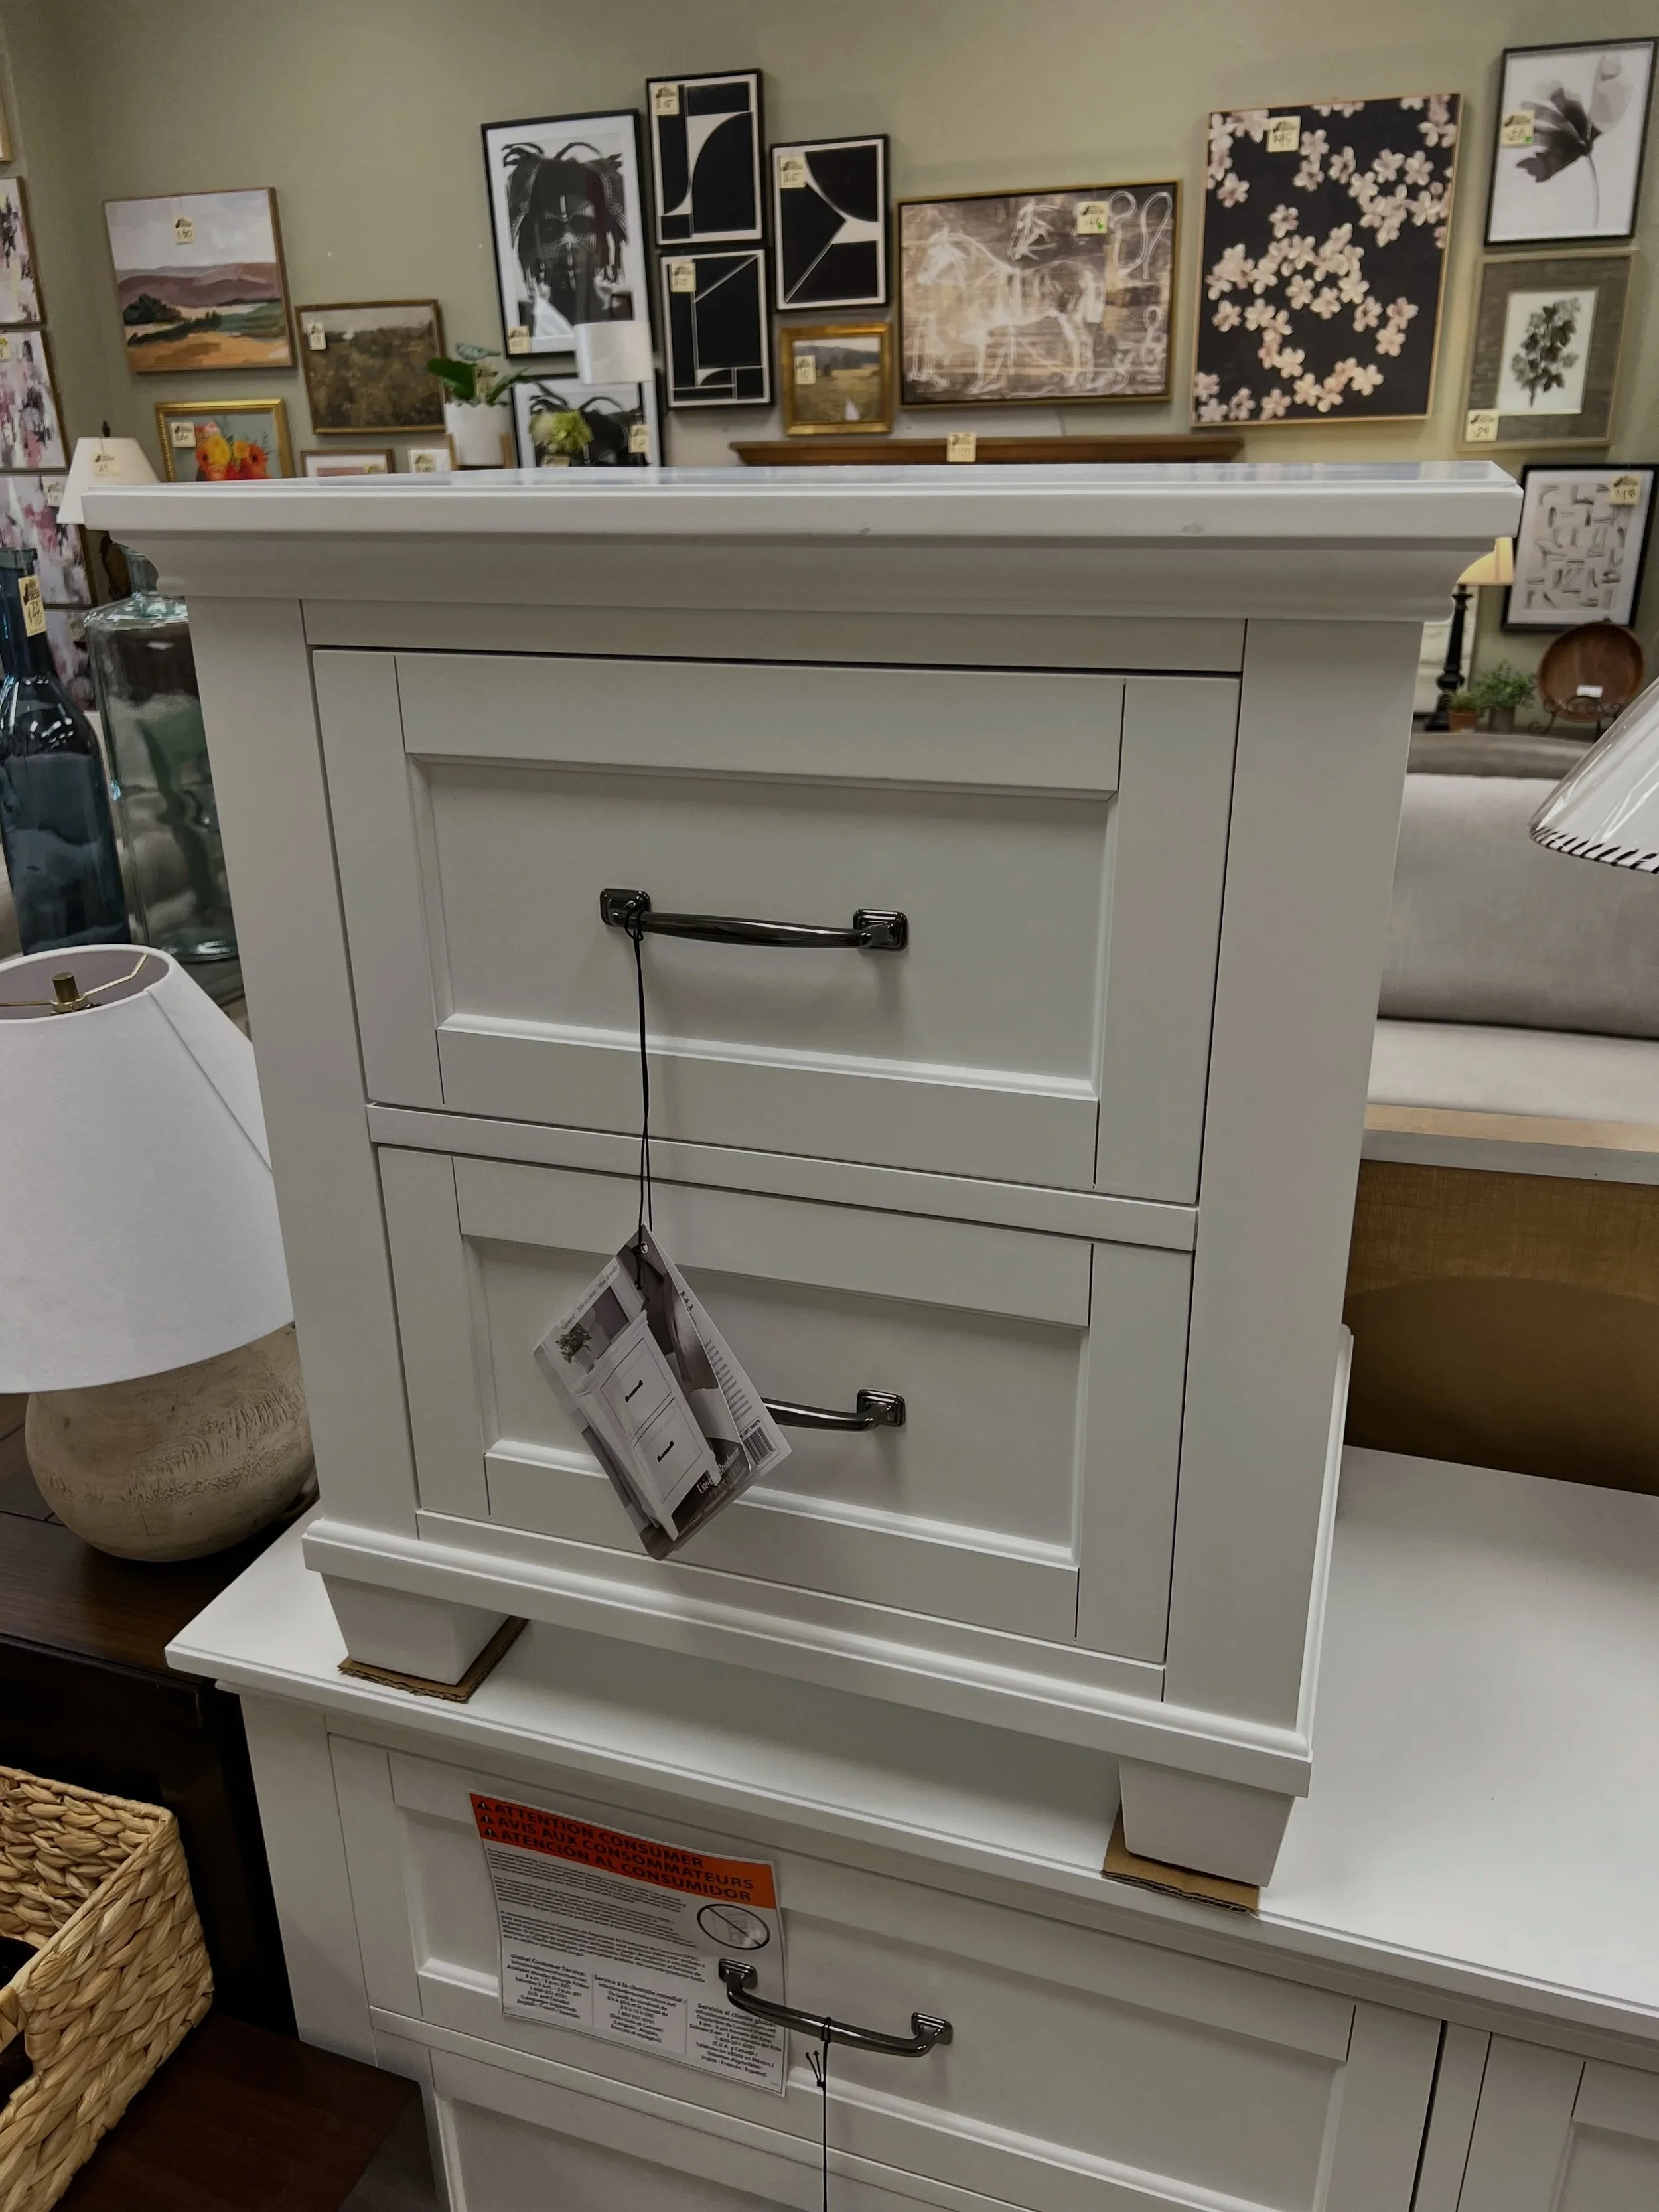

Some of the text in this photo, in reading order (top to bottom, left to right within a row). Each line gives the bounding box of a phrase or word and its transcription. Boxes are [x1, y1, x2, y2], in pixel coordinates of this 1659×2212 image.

[494, 1803, 703, 1868] ATTENTION CONSUMER
[498, 1816, 754, 1889] AVIS AUX CONSOMMATEURS
[502, 1830, 590, 1862] ATENCIÓN
[595, 1855, 619, 1870] AL
[621, 1863, 751, 1901] CONSUMIDOR
